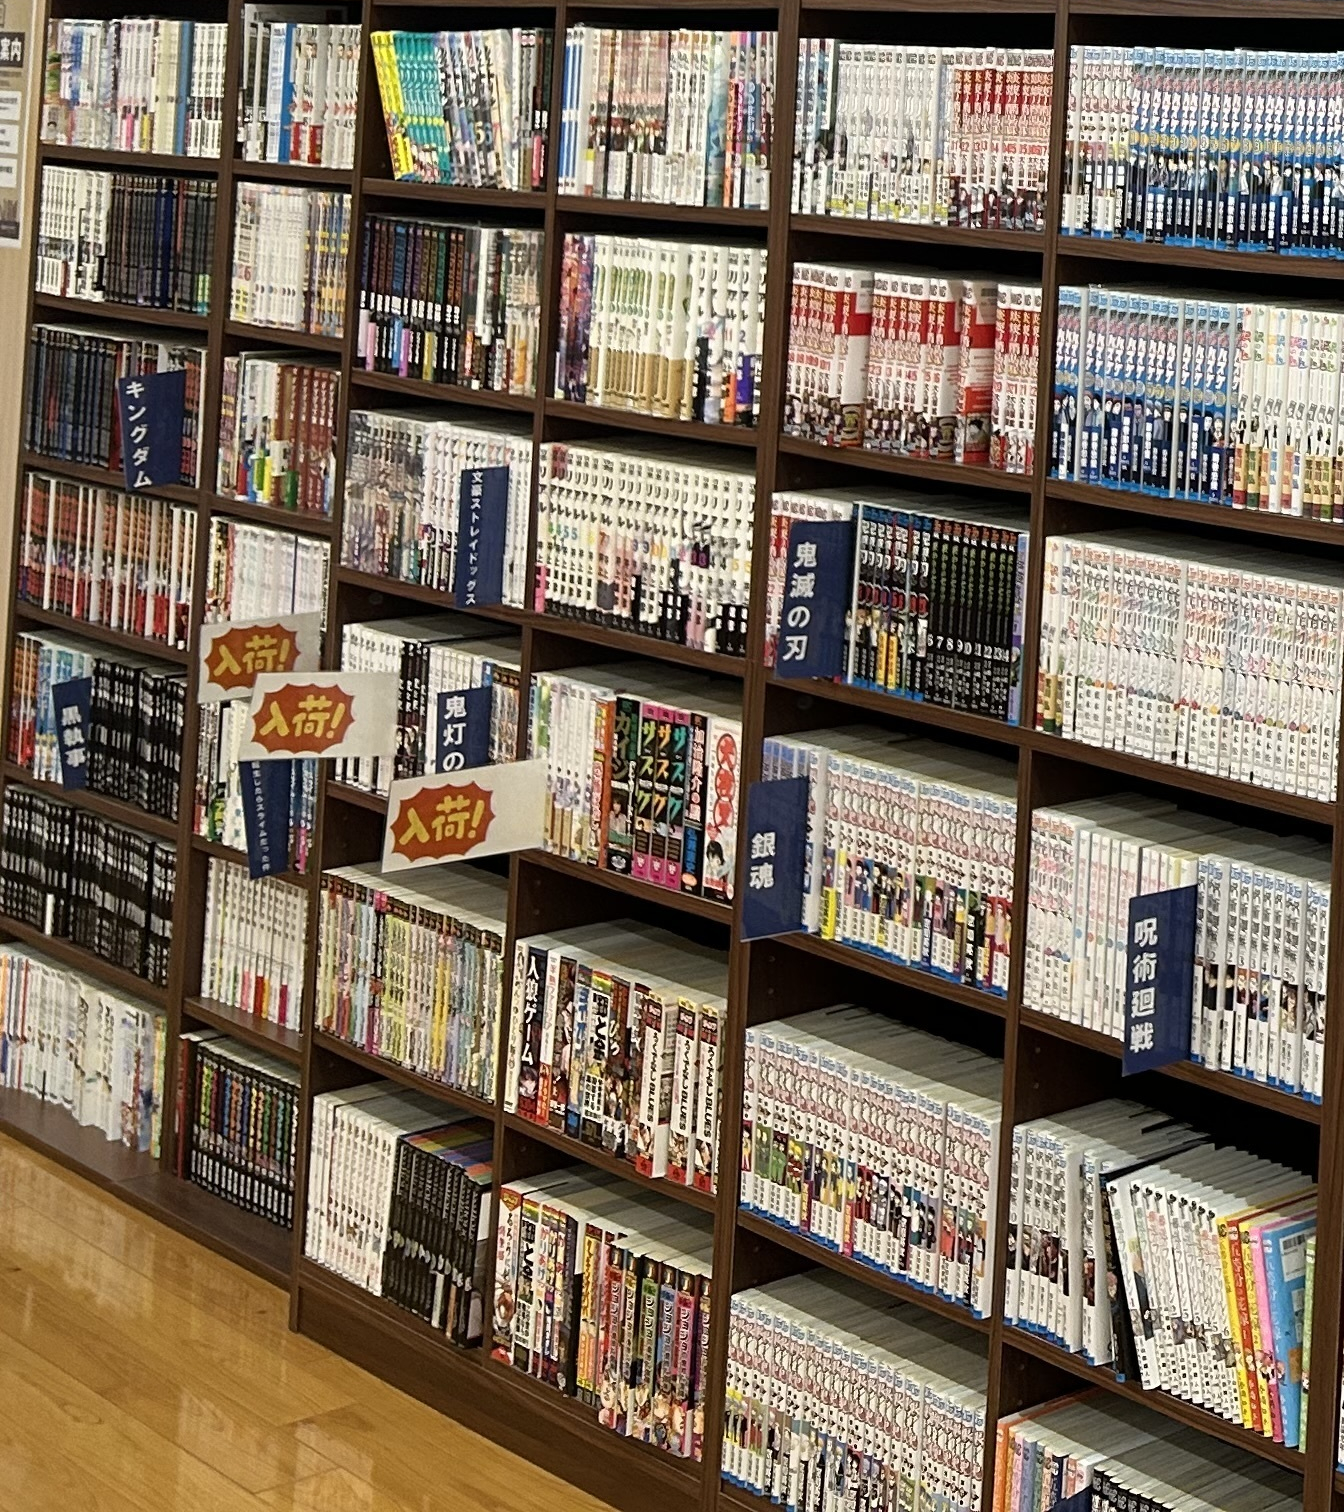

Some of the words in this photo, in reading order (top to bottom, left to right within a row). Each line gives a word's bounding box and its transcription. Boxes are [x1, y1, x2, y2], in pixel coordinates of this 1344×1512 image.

[125, 381, 152, 487] キングダム
[465, 471, 483, 605] 文豪ストレイドッグス
[783, 542, 817, 661] 鬼滅の刃
[61, 706, 86, 768] 黒執事
[442, 696, 467, 771] 鬼灯の
[749, 832, 776, 889] 銀魂
[521, 956, 540, 1065] 人狼ゲーム
[1130, 917, 1158, 1054] 呪術廻戦
